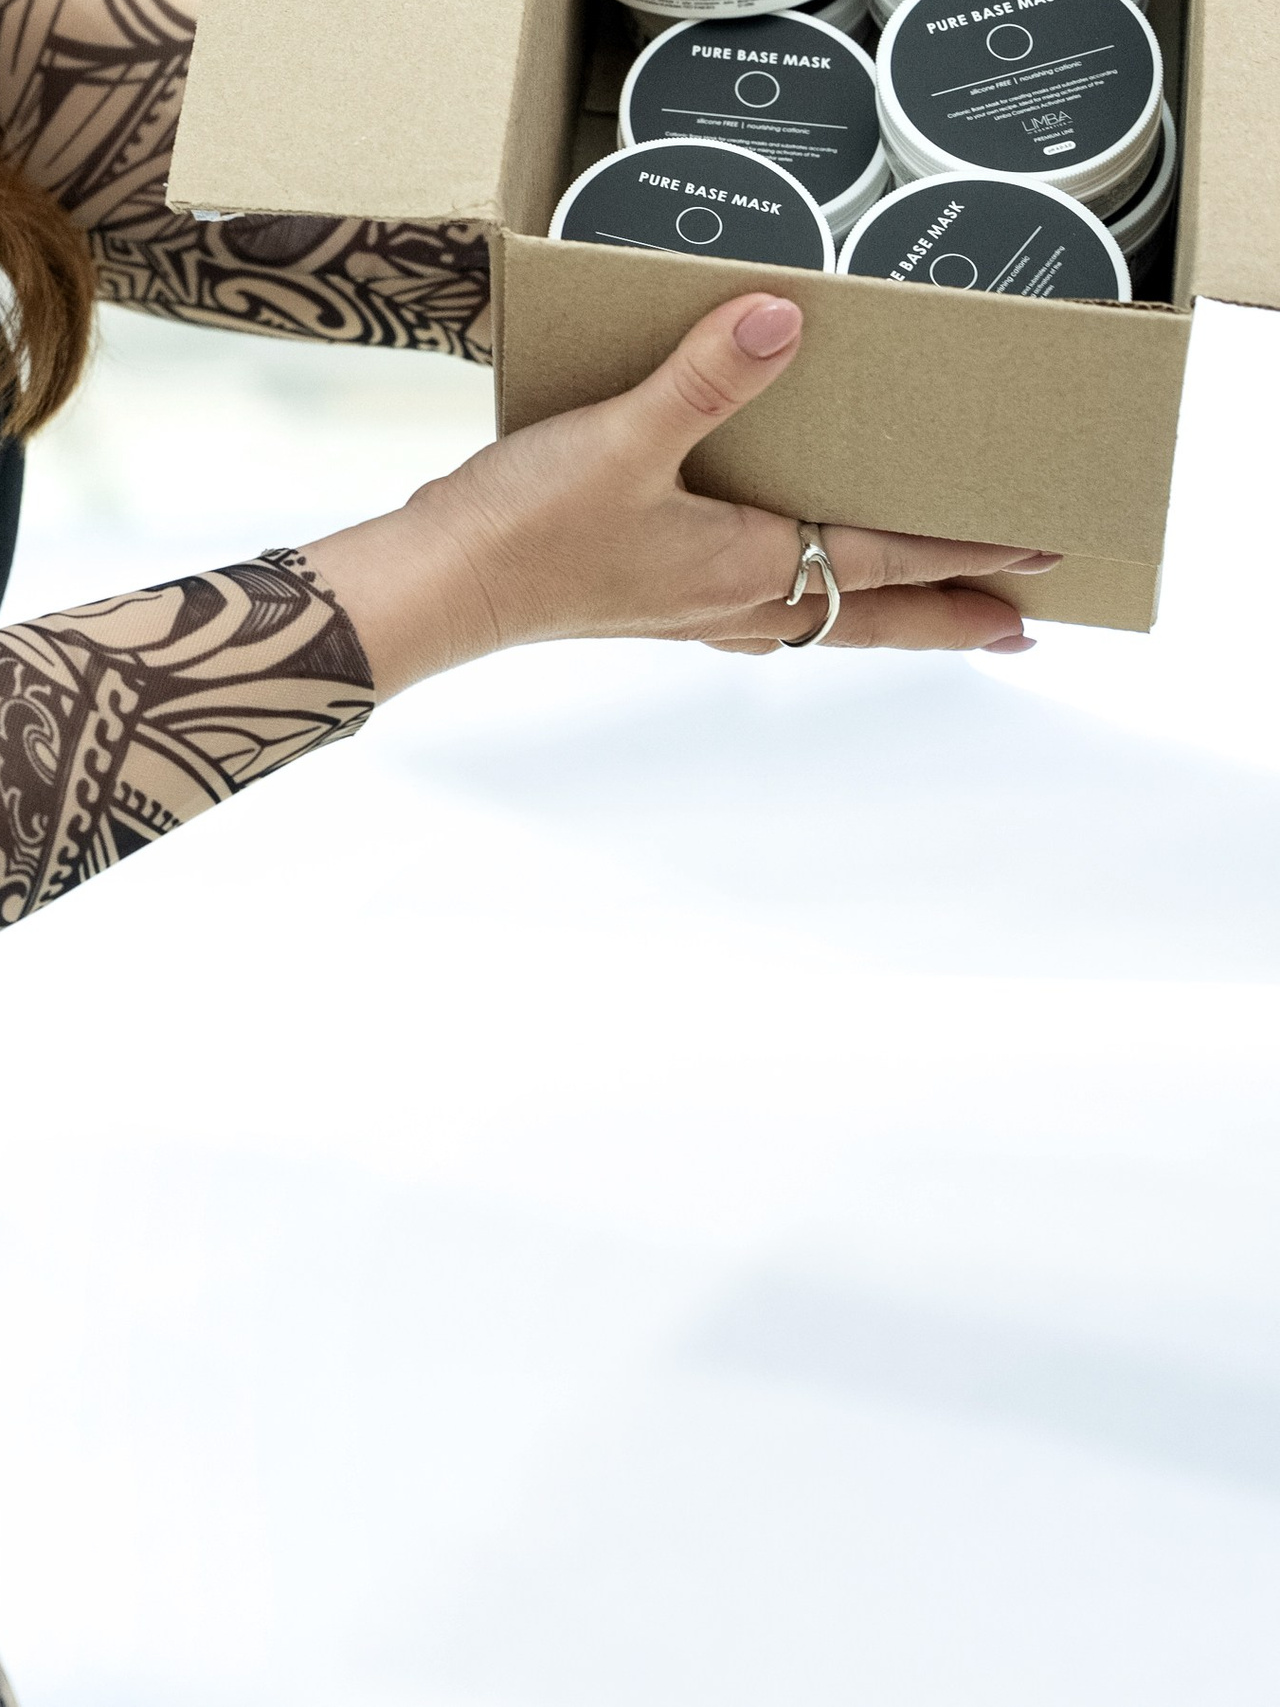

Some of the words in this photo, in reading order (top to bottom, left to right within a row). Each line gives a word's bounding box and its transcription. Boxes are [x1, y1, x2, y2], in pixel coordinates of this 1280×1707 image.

[926, 14, 969, 35] PURE
[970, 2, 1015, 23] BASE
[692, 45, 732, 60] PURE
[737, 49, 778, 65] BASE
[783, 54, 831, 69] MASK
[970, 85, 995, 95] silicone
[996, 80, 1012, 89] FREE
[1020, 69, 1054, 82] nourishing
[1054, 61, 1082, 72] cationic
[1049, 84, 1061, 92] and
[722, 120, 739, 128] FREE
[746, 124, 782, 133] nourishing
[782, 127, 811, 135] cationic
[1022, 110, 1072, 132] LIMBA
[1033, 132, 1061, 143] PREMIUM
[1061, 128, 1075, 136] LINE
[638, 172, 681, 191] PURE
[684, 182, 728, 203] BASE
[731, 194, 782, 216] MASK
[898, 238, 934, 272] BASE
[927, 200, 965, 240] MASK
[1010, 255, 1031, 278] cationic
